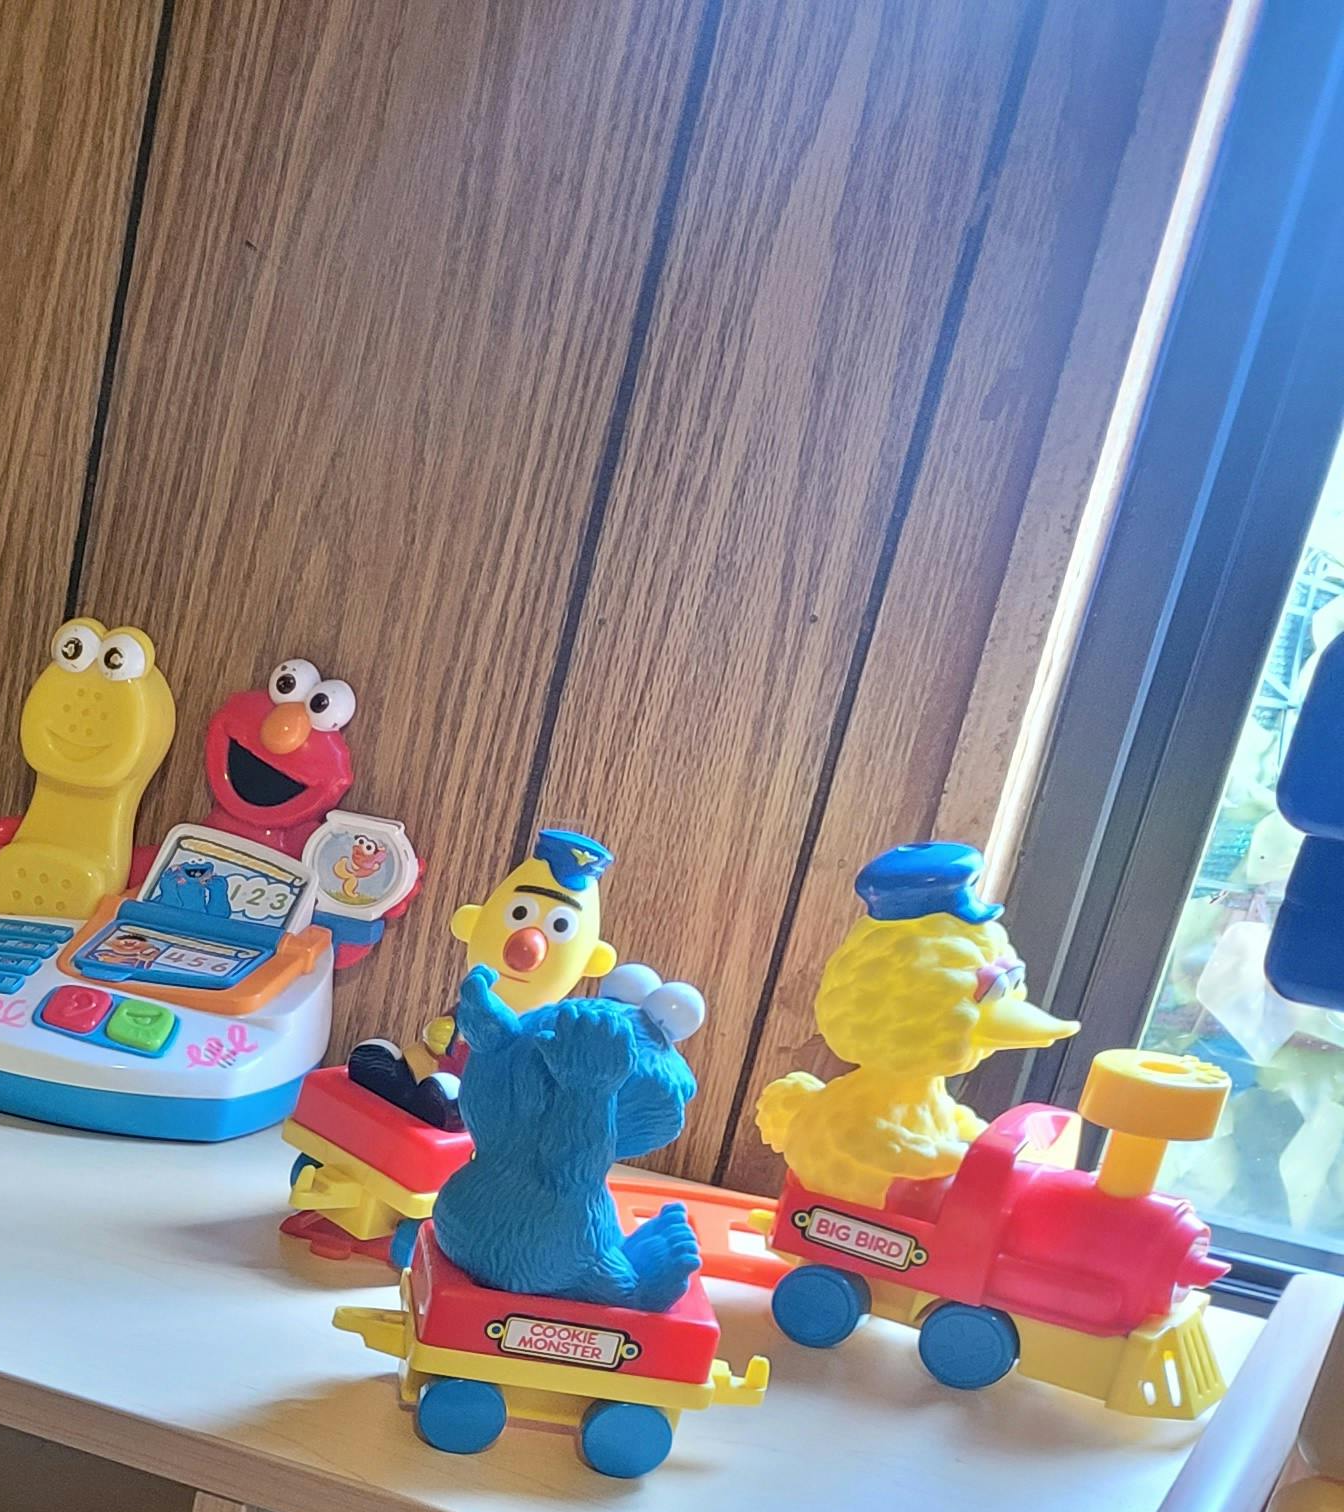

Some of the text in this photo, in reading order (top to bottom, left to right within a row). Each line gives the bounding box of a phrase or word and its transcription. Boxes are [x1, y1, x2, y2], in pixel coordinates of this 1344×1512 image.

[246, 888, 266, 906] 2
[269, 893, 289, 910] 3
[165, 951, 230, 973] 4 5 6
[816, 1218, 903, 1258] BIG BIRD
[530, 1324, 599, 1345] COOKIE
[518, 1336, 602, 1359] MONSTER
